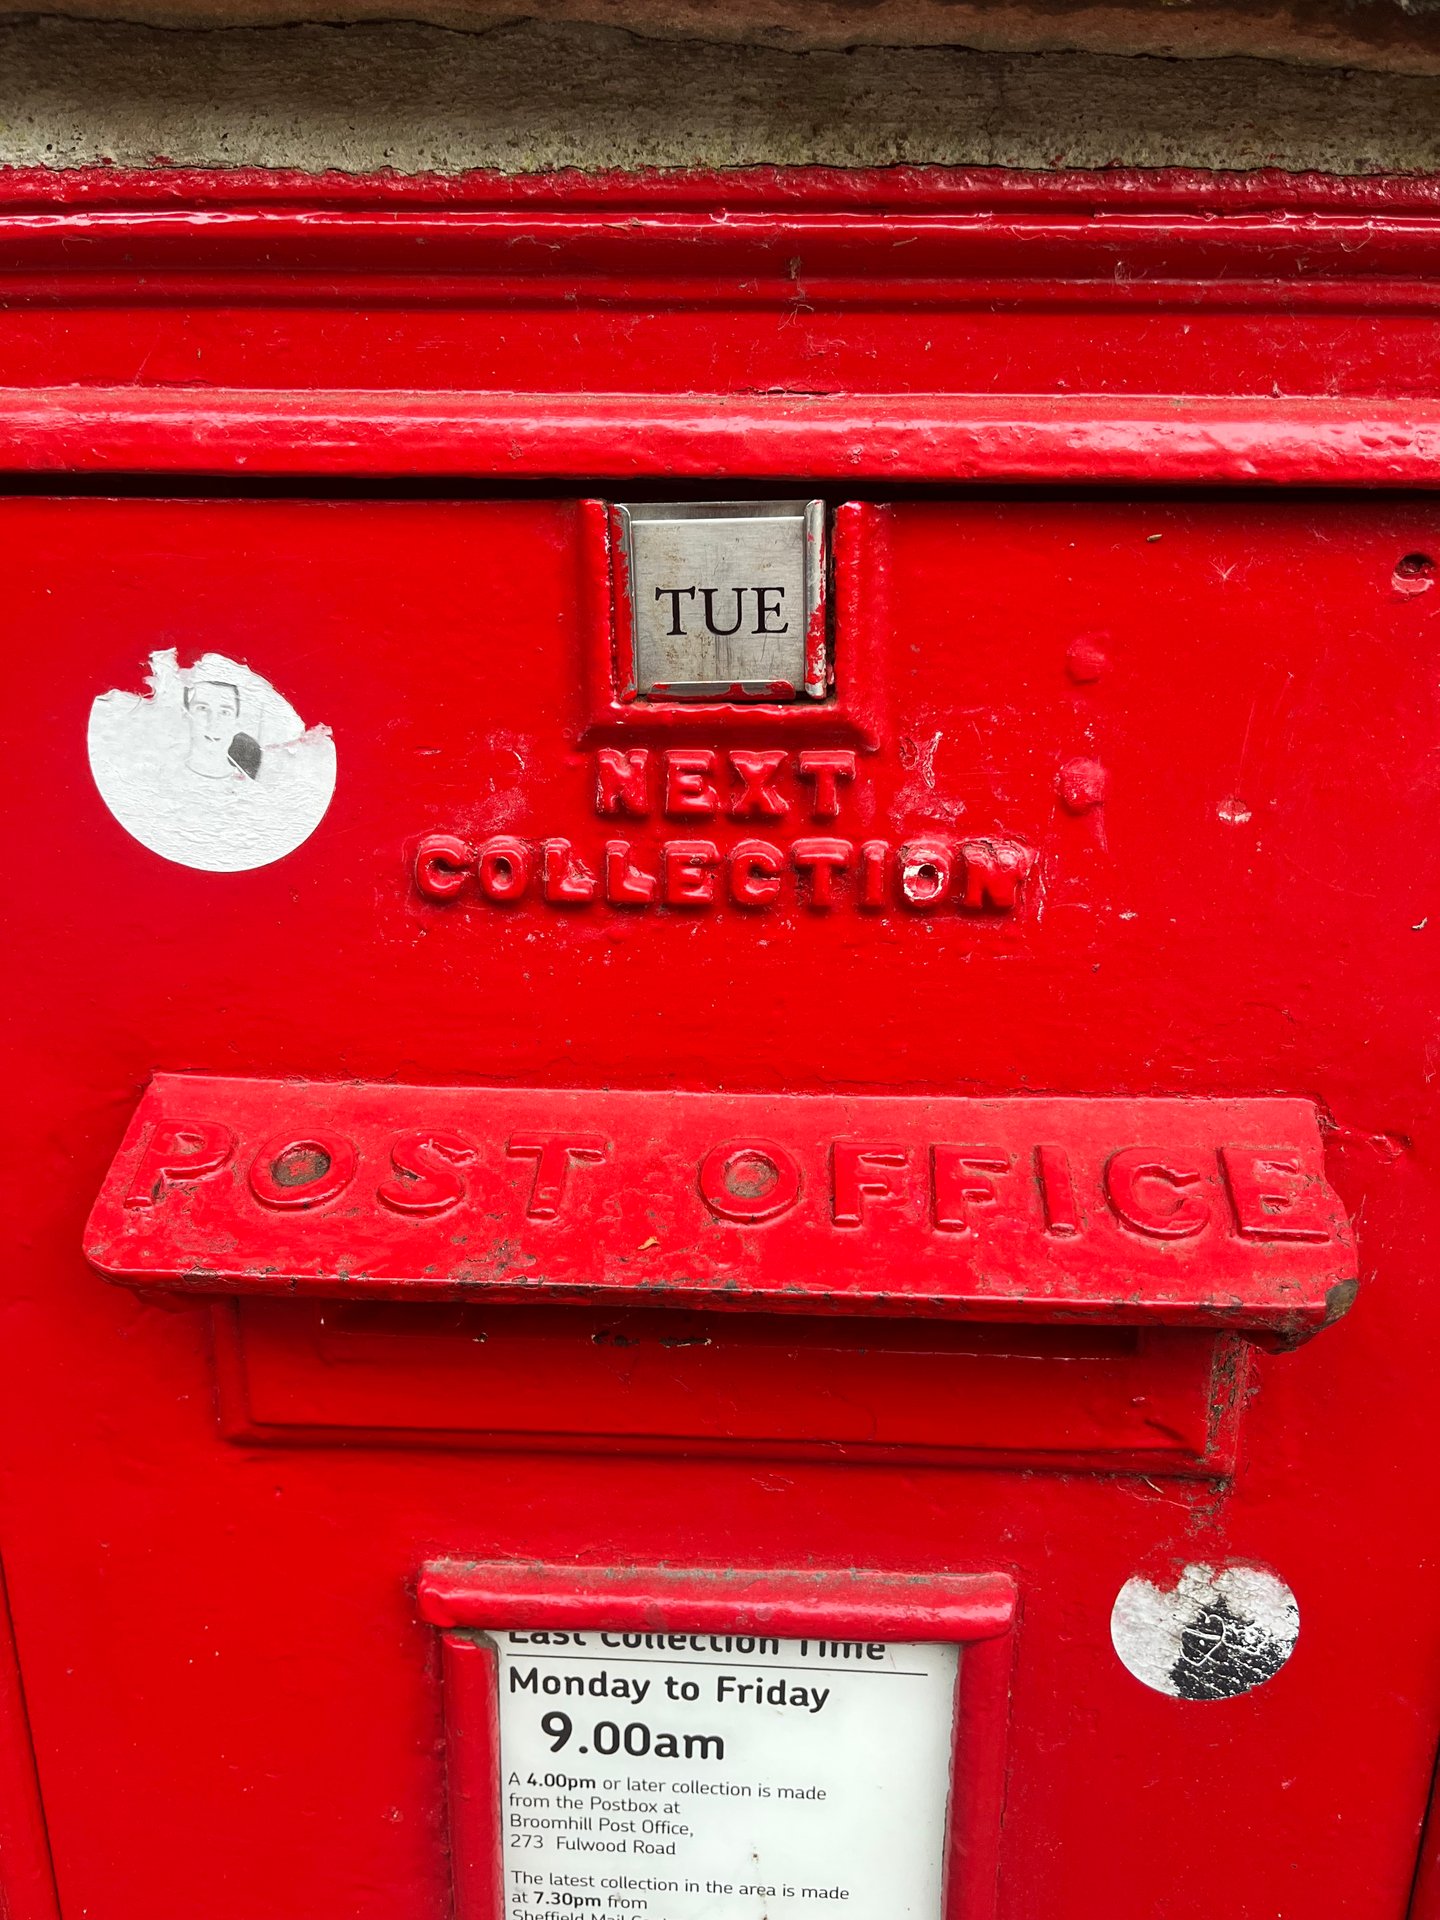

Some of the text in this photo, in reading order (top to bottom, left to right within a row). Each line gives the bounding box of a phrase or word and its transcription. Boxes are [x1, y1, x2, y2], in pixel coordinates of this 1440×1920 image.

[655, 587, 789, 636] TUE
[598, 748, 856, 815] NEXT
[416, 834, 1033, 908] COLLECTION
[125, 1118, 1331, 1243] POST OFFICE
[510, 1666, 829, 1713] Monday to Friday
[541, 1711, 724, 1760] 9.00am
[509, 1772, 826, 1800] A 4.00pm or later collection is made
[510, 1793, 680, 1814] from the Postbox at
[510, 1814, 694, 1837] Broomhill Post Office,
[511, 1834, 676, 1855] 273 Fulwood Road
[512, 1870, 849, 1899] The latest collection in the area is made
[512, 1891, 647, 1909] at 7.30pm from
